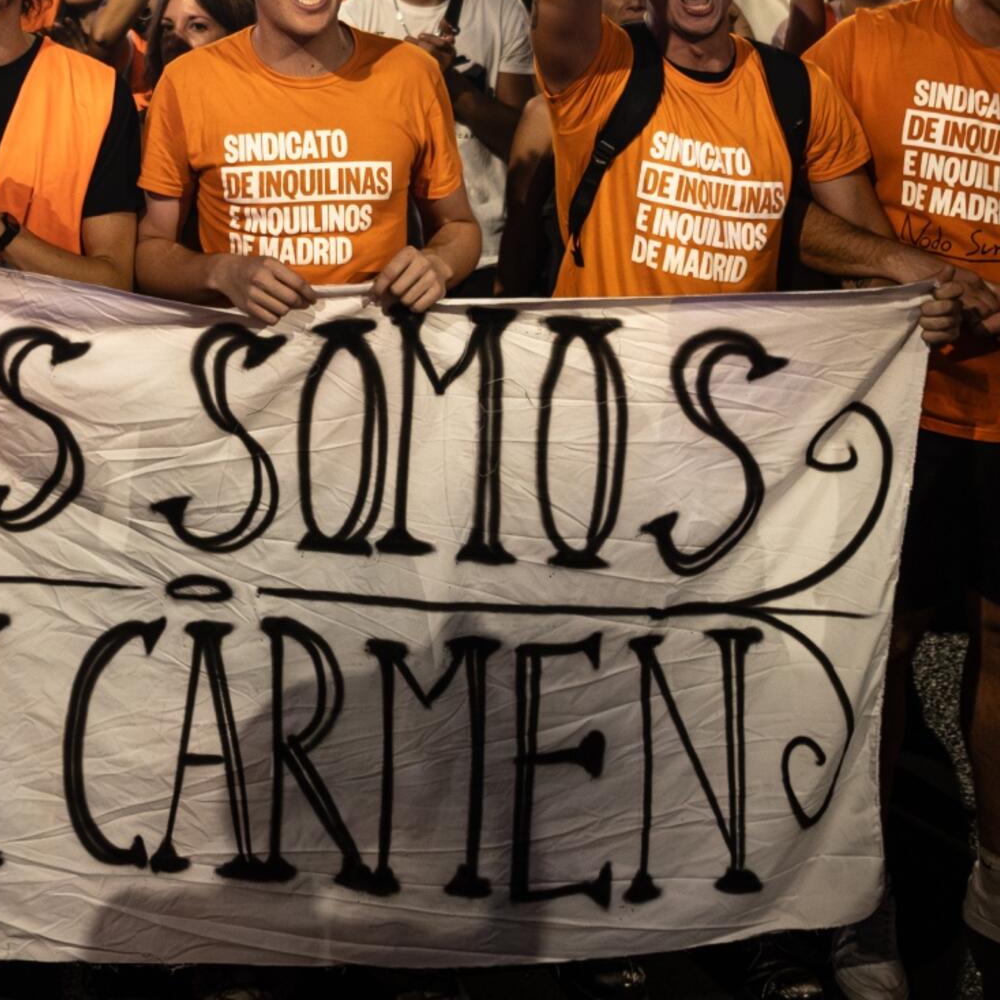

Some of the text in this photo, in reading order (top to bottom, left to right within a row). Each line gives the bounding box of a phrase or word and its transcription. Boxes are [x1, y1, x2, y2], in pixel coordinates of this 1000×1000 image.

[223, 128, 348, 164] SINDICATO
[907, 115, 940, 143] DE
[650, 131, 752, 177] SINDICATO
[903, 149, 918, 176] E
[226, 166, 389, 200] DE INQUILINAS
[642, 166, 784, 215] DE INQUILINAS
[901, 180, 928, 211] DE
[229, 203, 373, 236] E INQUILINOS
[636, 202, 768, 252] E INQUILINOS
[901, 213, 952, 252] Nodo
[228, 231, 353, 265] DE MADRID
[631, 234, 748, 284] DE MADRID
[150, 305, 789, 576] SOMOS
[63, 616, 765, 910] CARMEN
